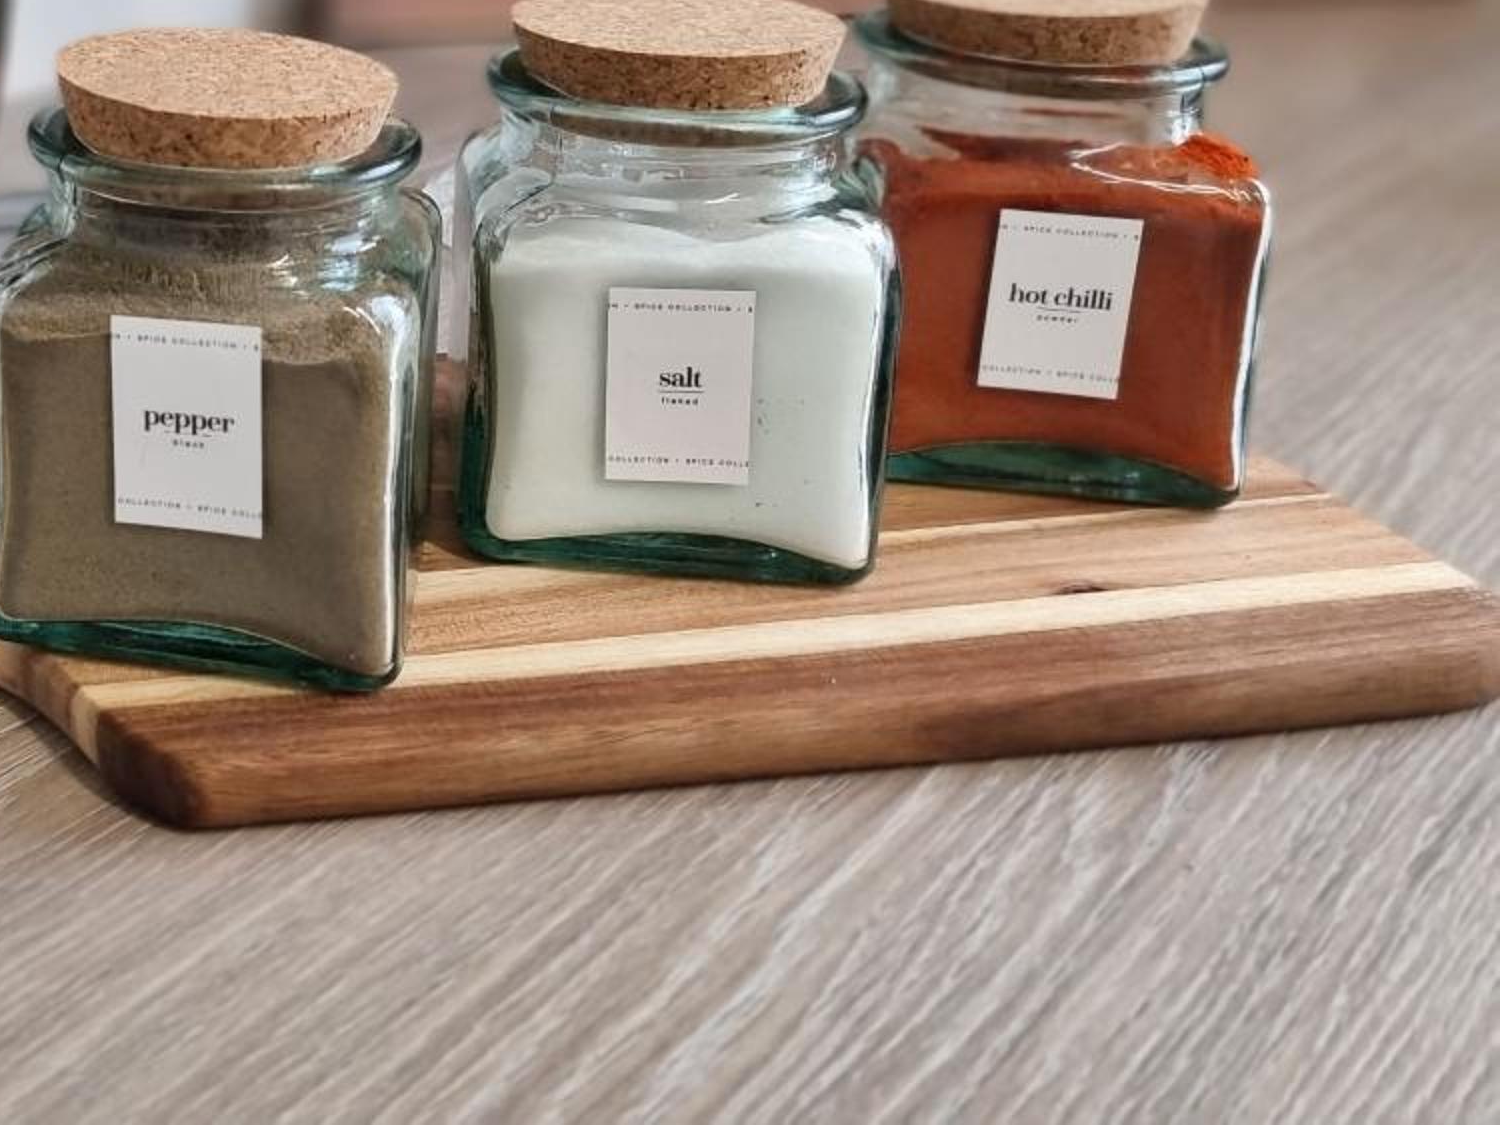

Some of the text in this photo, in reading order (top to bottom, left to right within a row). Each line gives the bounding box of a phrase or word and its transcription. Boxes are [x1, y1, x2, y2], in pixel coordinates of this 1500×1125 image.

[668, 303, 732, 313] COLLECTION
[1008, 282, 1114, 310] hot chilli
[659, 366, 703, 389] salt
[143, 409, 235, 436] pepper
